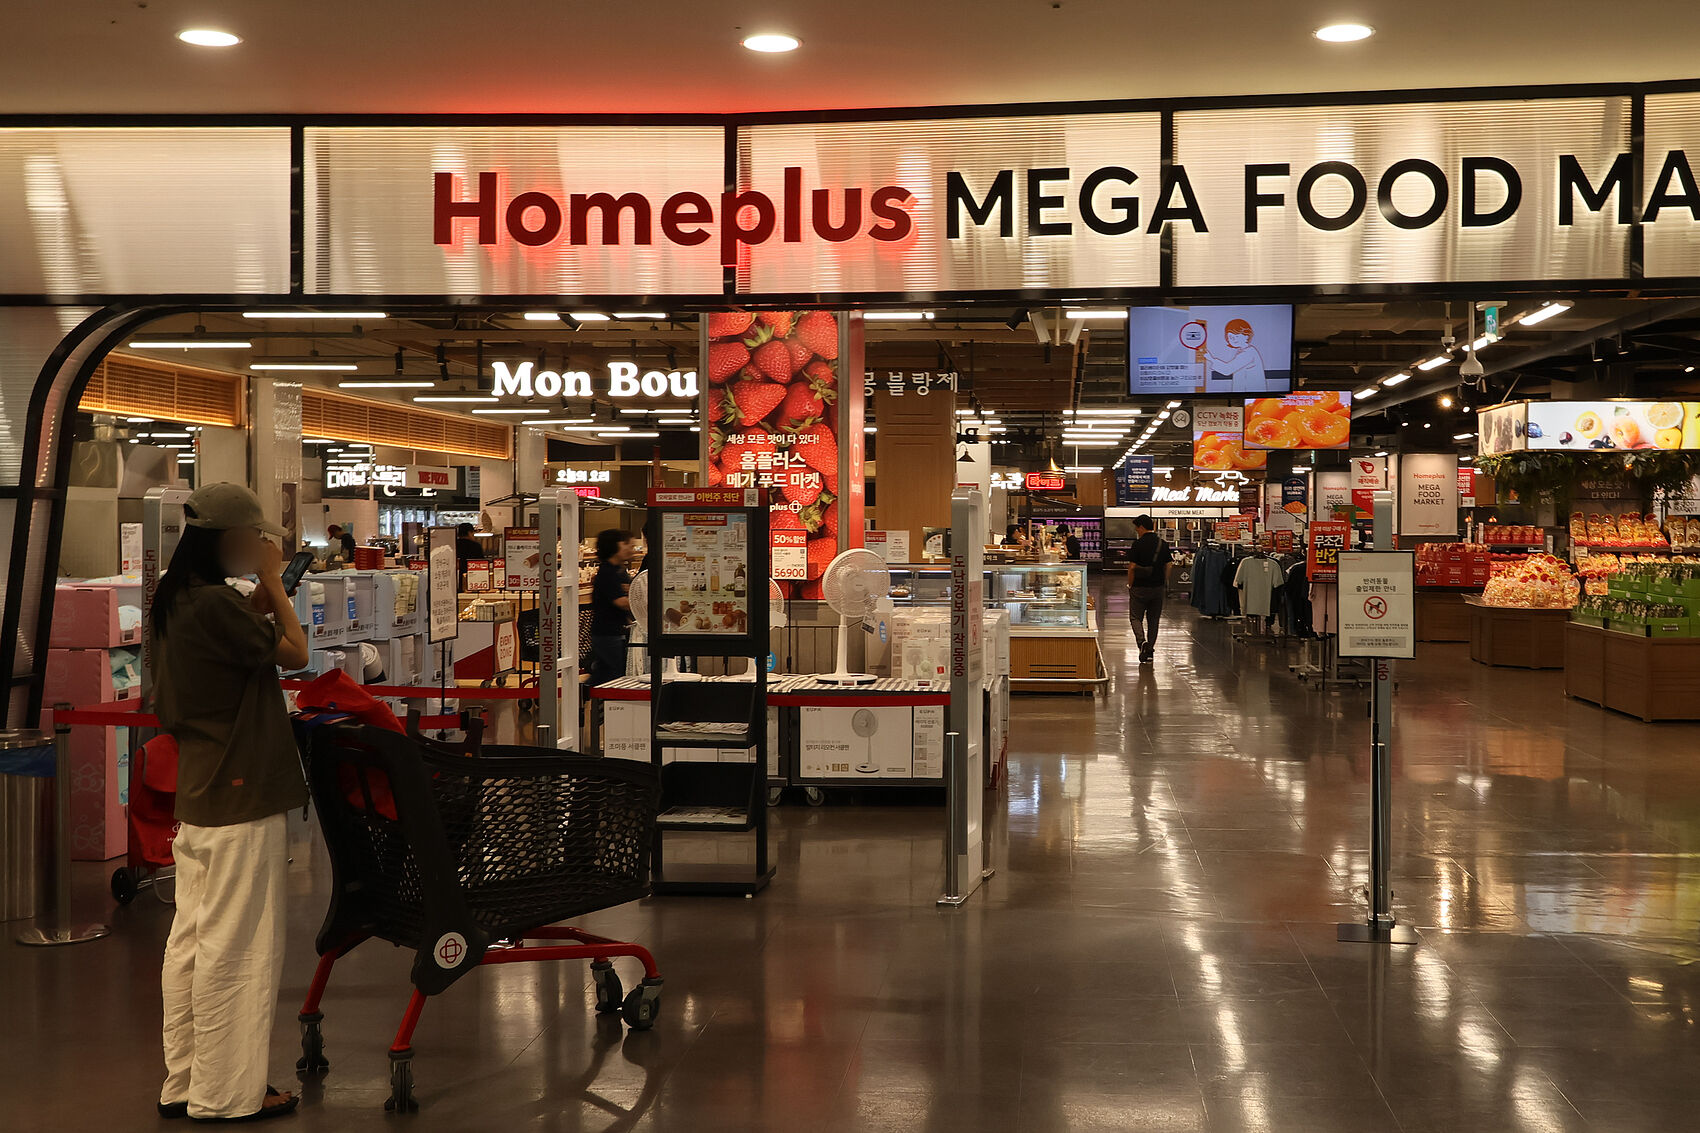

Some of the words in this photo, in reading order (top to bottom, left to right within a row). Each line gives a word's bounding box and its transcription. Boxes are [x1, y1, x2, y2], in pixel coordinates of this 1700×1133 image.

[433, 166, 914, 267] Homeplus
[947, 165, 1208, 240] MEGA
[1244, 156, 1522, 233] FOOD
[491, 361, 594, 397] Mon
[607, 361, 699, 397] Bou
[1197, 411, 1218, 420] CCTV
[1219, 411, 1239, 420] 녹화중
[726, 434, 745, 444] 세상
[747, 434, 765, 444] 모든
[767, 434, 785, 444] 맛이
[787, 434, 797, 444] 다
[798, 434, 820, 444] 있다!
[740, 451, 806, 470] 홈플러스
[726, 472, 756, 488] 메가
[758, 472, 789, 488] 푸드
[790, 472, 820, 489] 마켓
[696, 492, 721, 502] 이번주
[722, 492, 740, 502] 전단
[774, 534, 806, 544] 50%할인
[1314, 534, 1344, 547] 무조건
[952, 555, 966, 628] 도난경보기
[1355, 585, 1381, 593] 출입제한
[1383, 585, 1397, 593] 안내
[952, 632, 966, 677] 작동중
